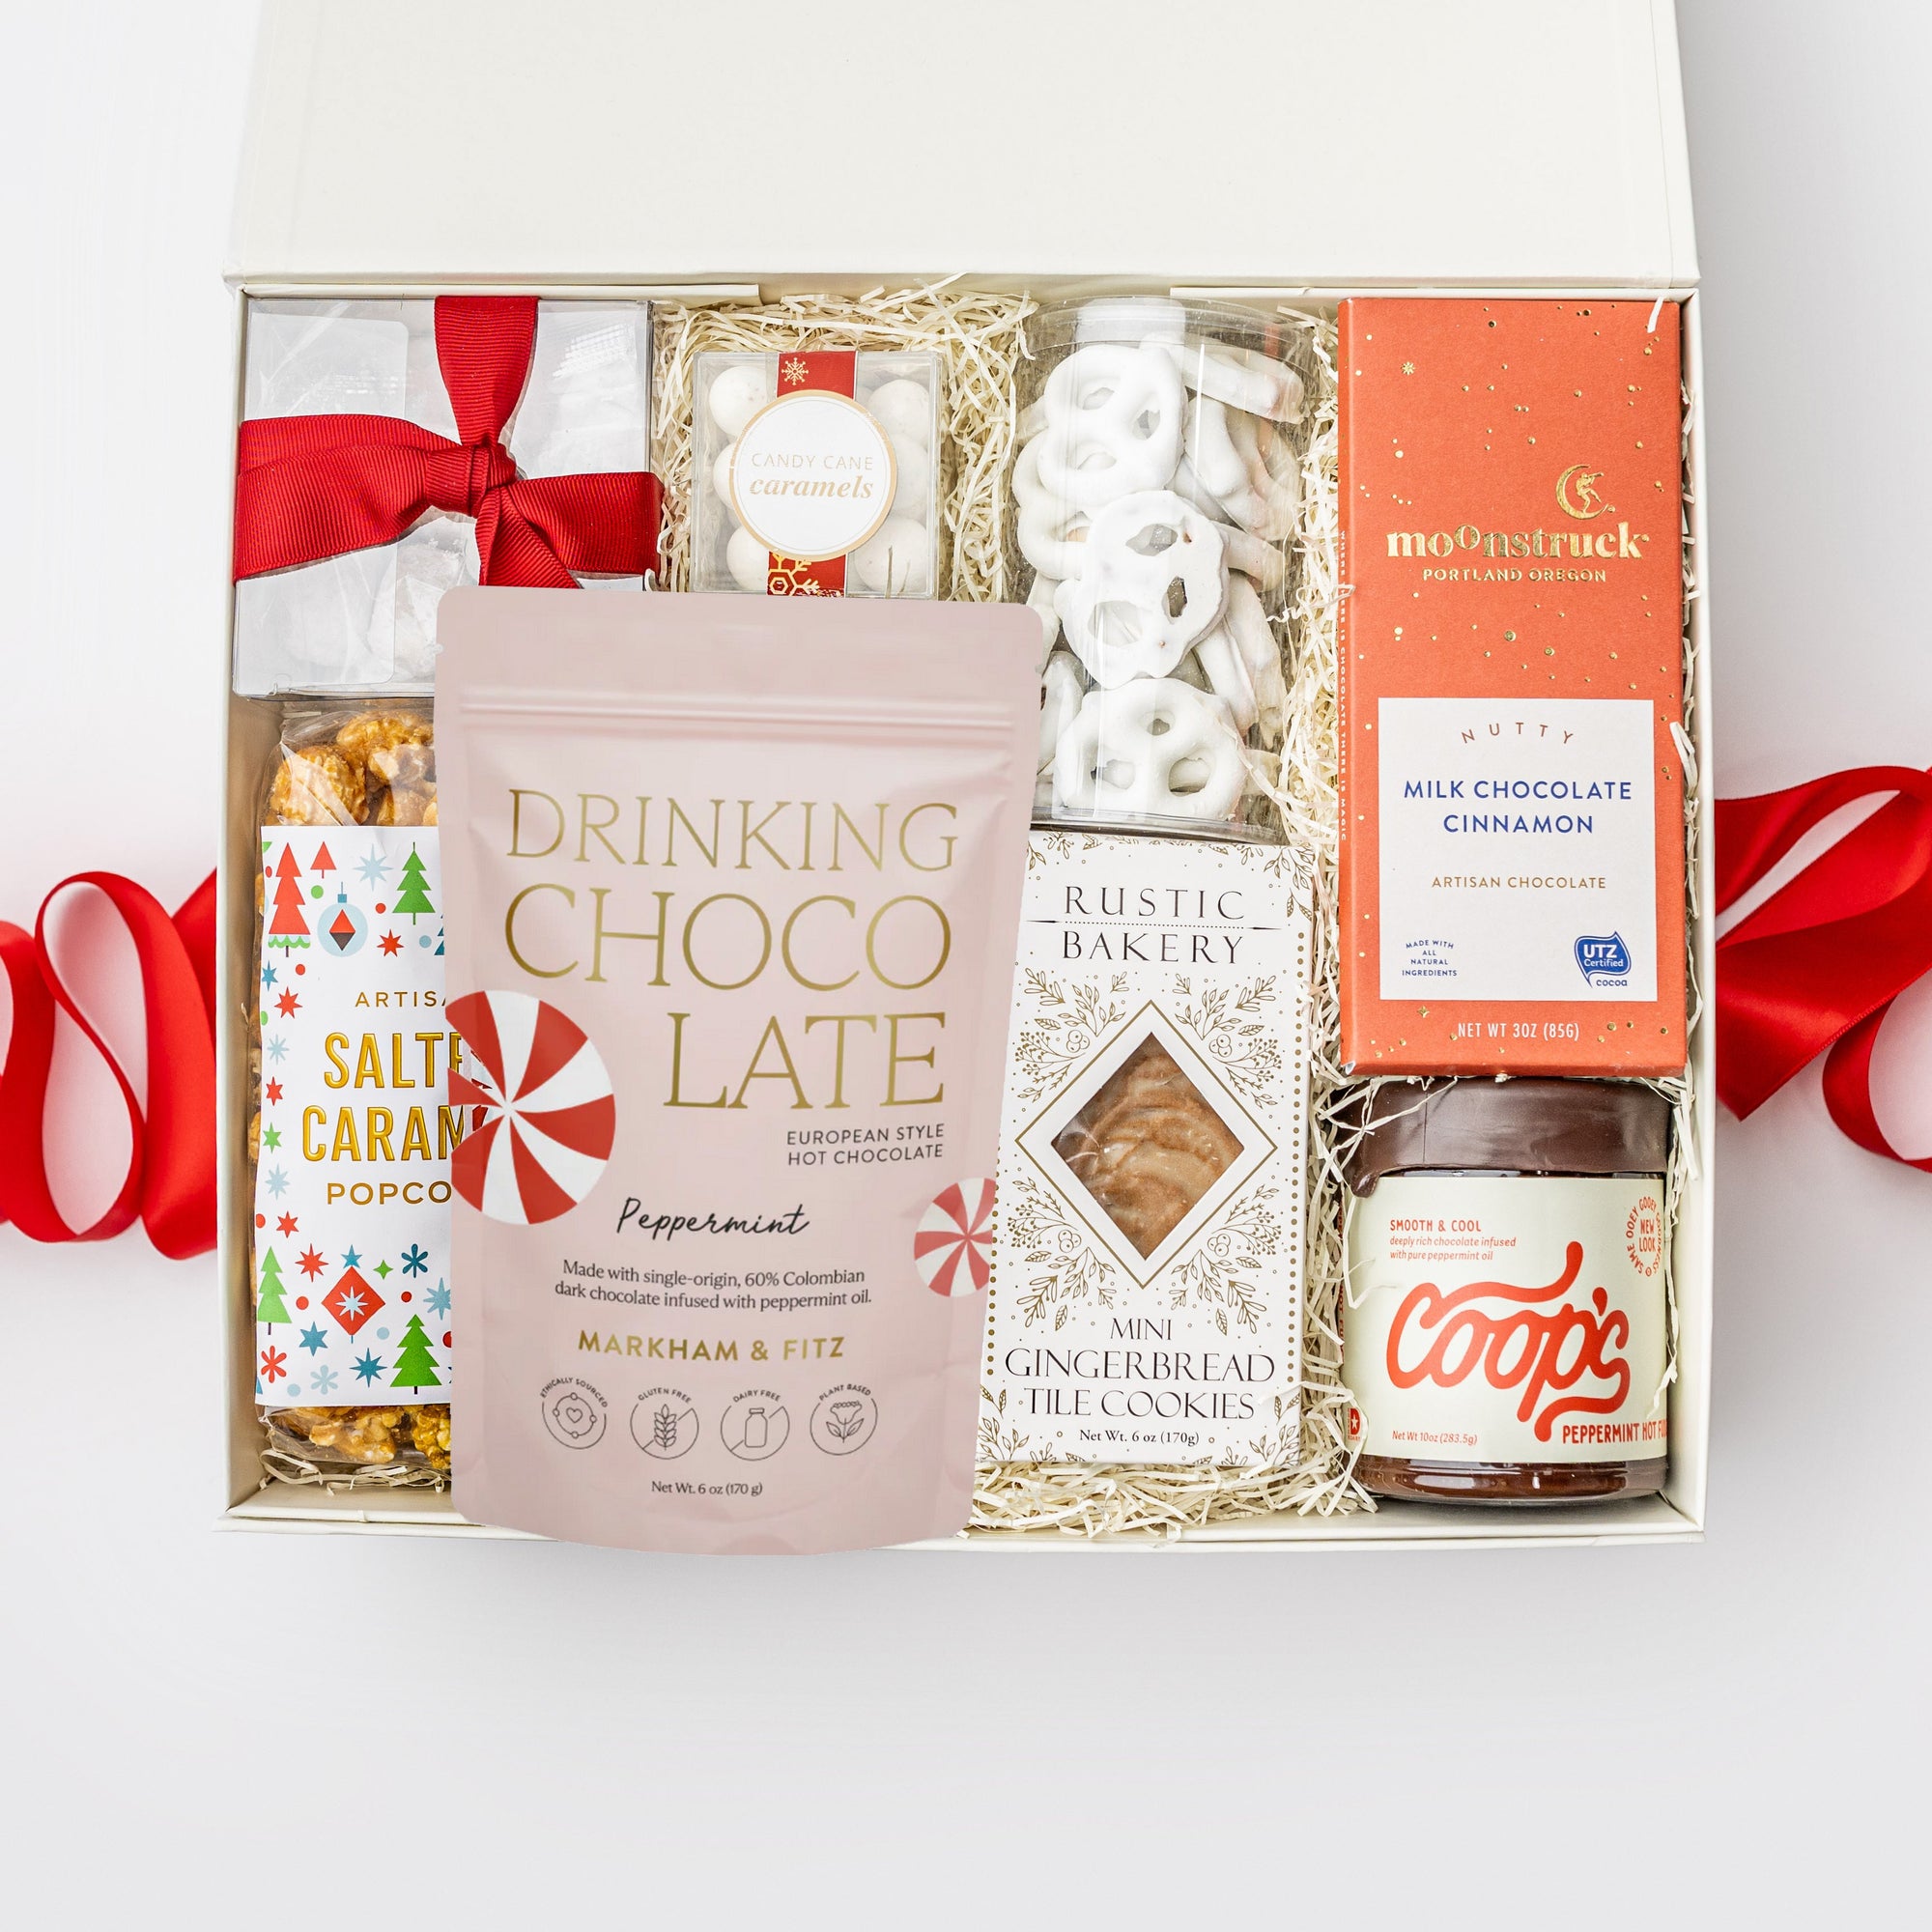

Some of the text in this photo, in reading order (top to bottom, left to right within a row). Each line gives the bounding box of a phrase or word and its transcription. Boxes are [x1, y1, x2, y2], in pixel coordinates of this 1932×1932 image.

[752, 452, 873, 470] CANDY CANE
[750, 473, 873, 498] caramels
[1386, 522, 1646, 558] moonstruck
[1423, 568, 1606, 582] PORTLAND OREGON
[1462, 723, 1574, 744] NUTTY
[1404, 781, 1632, 800] MILK CHOCOLATE
[507, 788, 958, 871] DRINKING
[1443, 814, 1593, 834] CINNAMON
[1432, 876, 1606, 889] ARTISAN CHOCOLATE
[1065, 886, 1244, 920] RUSTIC
[504, 883, 951, 991] CHOCO
[1406, 940, 1454, 950] MADE WITH
[1063, 931, 1243, 964] BAKERY
[1583, 944, 1618, 958] UTZ
[1584, 958, 1624, 968] Certified
[1596, 979, 1628, 987] cocoa
[355, 991, 446, 1007] ARTIS
[1458, 1023, 1482, 1037] NET
[1487, 1023, 1507, 1037] WT
[1543, 1023, 1579, 1041] (85G)
[663, 1011, 946, 1110] LATE
[786, 1122, 945, 1146] EUROPEAN STYLE
[787, 1144, 944, 1166] HOT CHOCOLATE
[616, 1197, 810, 1241] Peppermint
[1390, 1219, 1481, 1232] SMOOTH & COOL
[1640, 1219, 1654, 1234] NEW
[1389, 1236, 1516, 1248] deeply rich chocolate infused
[1639, 1237, 1656, 1252] LOOK
[1390, 1250, 1493, 1263] with pure peppermint oil
[563, 1260, 865, 1289] Made with single-origin, 60% Colombian
[555, 1282, 871, 1312] dark chocolate infused with peppermint oil.
[1110, 1318, 1172, 1341] MINI
[579, 1330, 845, 1361] MARKHAM & FITZ
[1005, 1349, 1275, 1382] GINGERBREAD
[540, 1378, 608, 1408] ETHICALLY SOURCED
[638, 1387, 692, 1404] GLUTEN FREE
[733, 1390, 781, 1403] DAIRY FREE
[819, 1383, 871, 1401] PLANT BASED
[1024, 1388, 1254, 1420] TILE COOKIES
[1080, 1429, 1200, 1446] Net Wt. 6 oz (170g)
[1392, 1431, 1478, 1446] Net Wt 10oz (283.5g)
[1563, 1423, 1639, 1444] PEPPERMINT
[1642, 1421, 1656, 1441] HOT
[651, 1481, 762, 1496] Net Wt. 6 oz (170 g)
